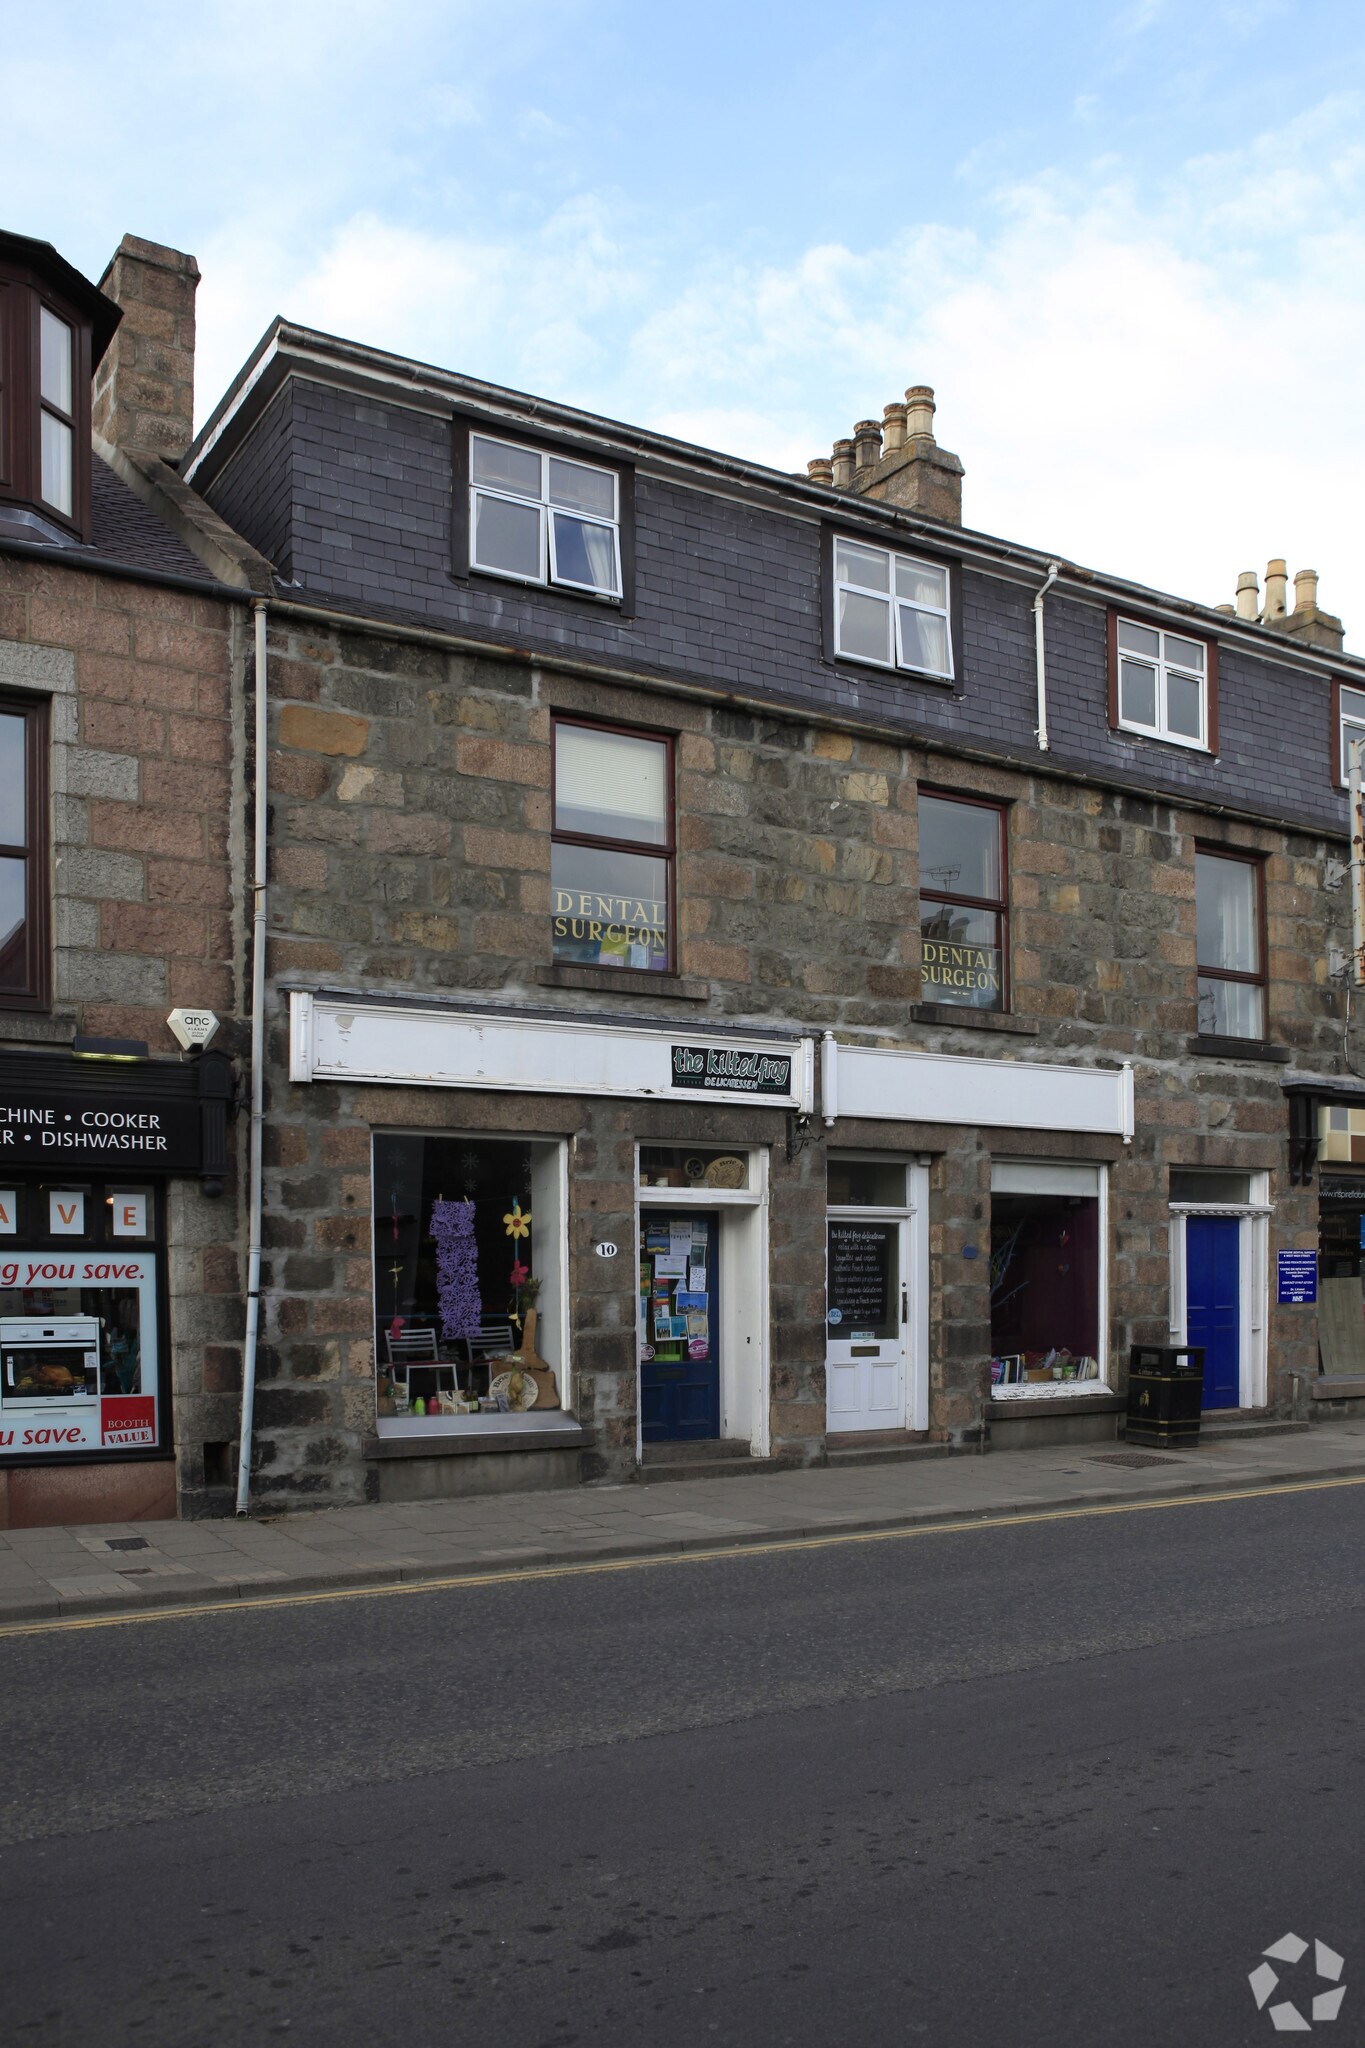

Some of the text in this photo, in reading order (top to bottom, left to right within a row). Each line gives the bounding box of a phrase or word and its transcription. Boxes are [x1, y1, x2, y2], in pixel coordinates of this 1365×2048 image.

[555, 891, 665, 925] DENTAL
[554, 917, 666, 949] SURGEON
[923, 943, 997, 970] DENTAL
[920, 964, 1000, 992] SURGEON
[184, 1016, 210, 1026] anc
[674, 1048, 790, 1085] the kilted frog
[704, 1076, 759, 1090] DELICATESSEN
[81, 1111, 161, 1129] COOKER
[41, 1131, 168, 1150] DISHWASHER
[601, 1244, 615, 1256] 10
[25, 1263, 75, 1286] you
[82, 1263, 145, 1280] save.
[108, 1419, 149, 1428] BOOTH
[22, 1426, 87, 1446] save.
[108, 1431, 149, 1444] VALUE
